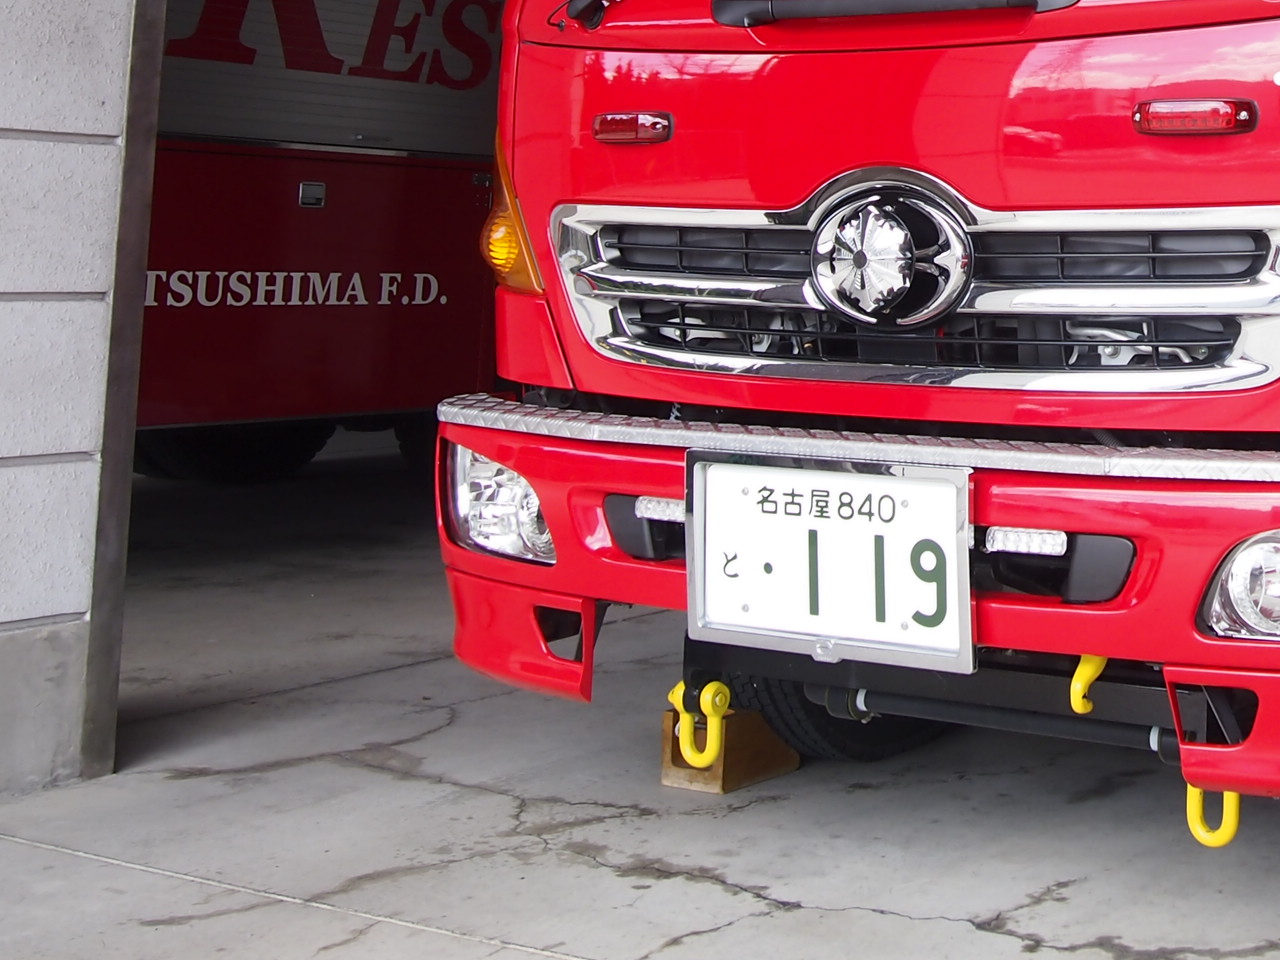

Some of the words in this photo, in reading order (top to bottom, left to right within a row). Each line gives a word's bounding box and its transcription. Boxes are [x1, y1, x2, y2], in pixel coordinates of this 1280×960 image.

[144, 270, 368, 307] TSUSHIMA
[377, 273, 448, 305] F.D.
[722, 551, 740, 578] と
